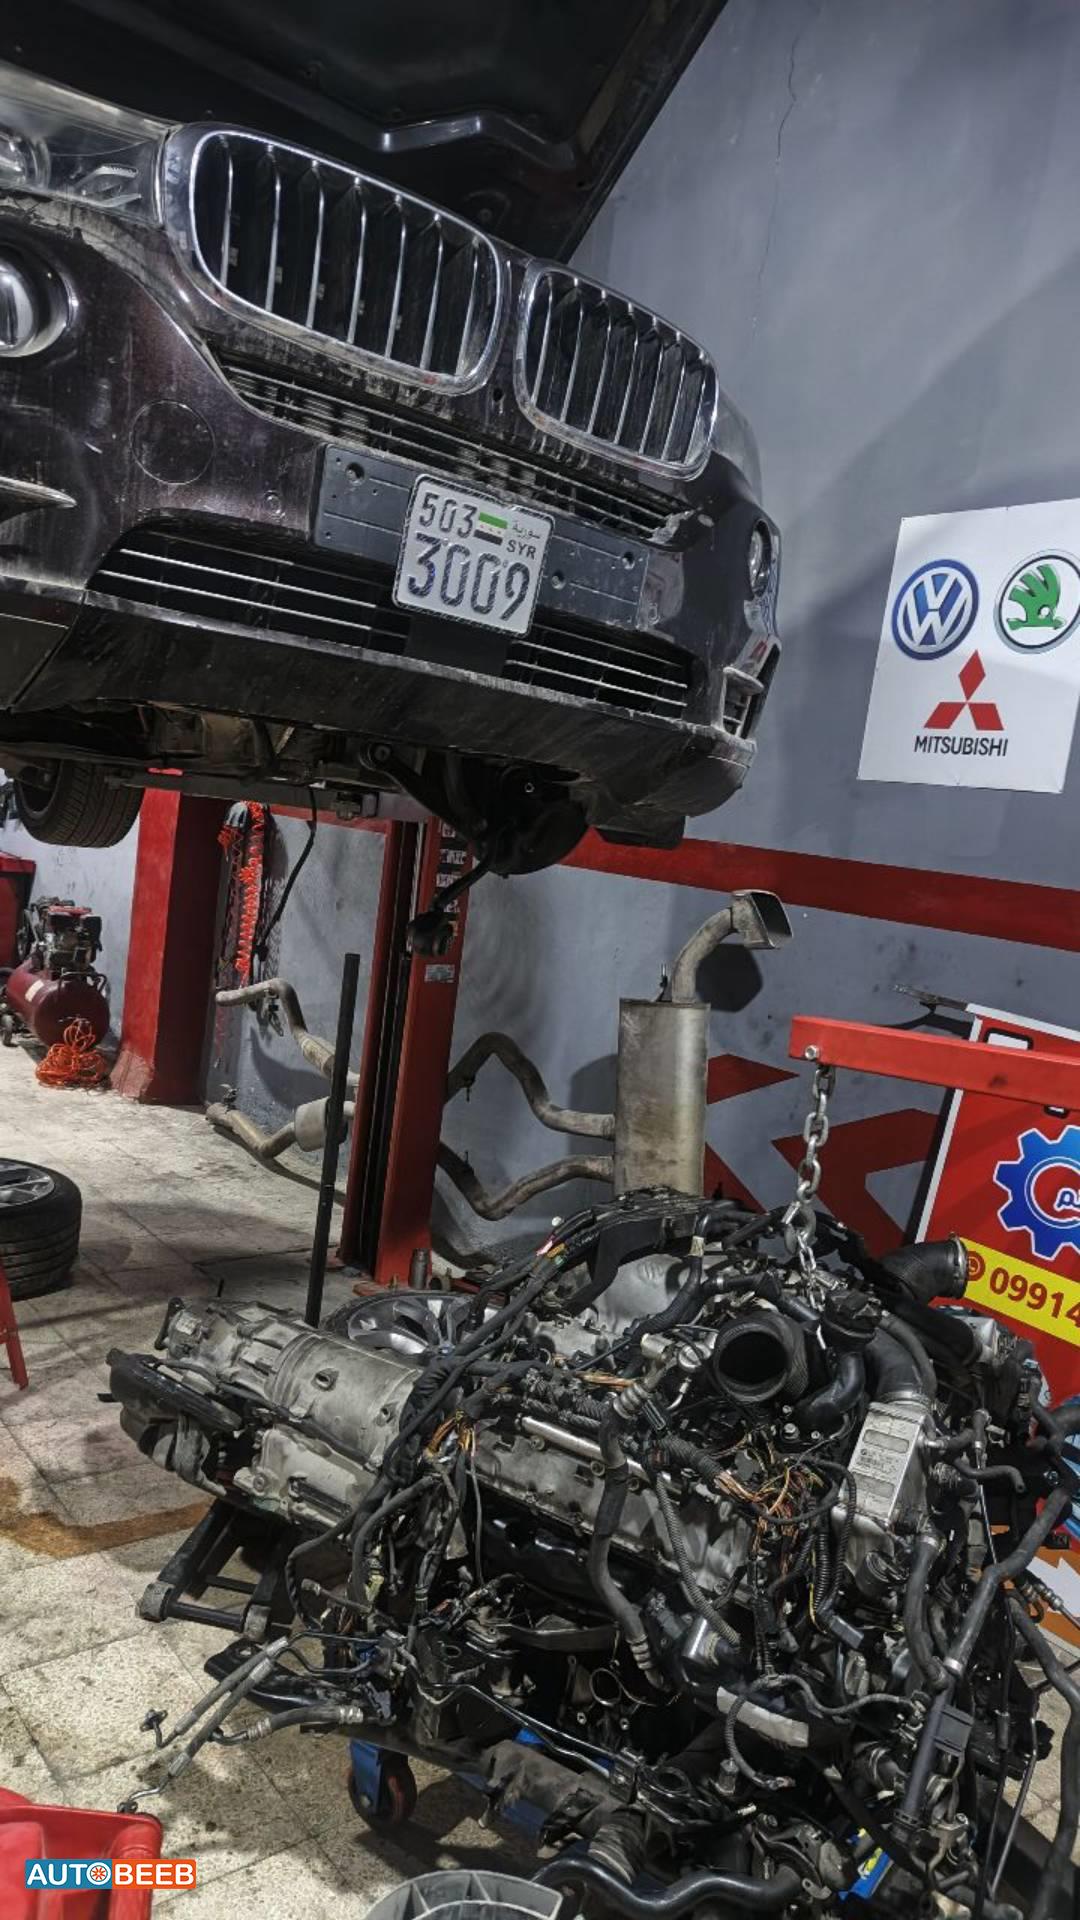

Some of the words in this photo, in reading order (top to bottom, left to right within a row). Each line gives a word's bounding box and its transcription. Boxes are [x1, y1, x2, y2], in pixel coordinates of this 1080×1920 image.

[419, 492, 478, 539] 503
[507, 539, 537, 560] SYR
[408, 532, 530, 621] 3009
[914, 735, 1009, 757] MITSUBISHI
